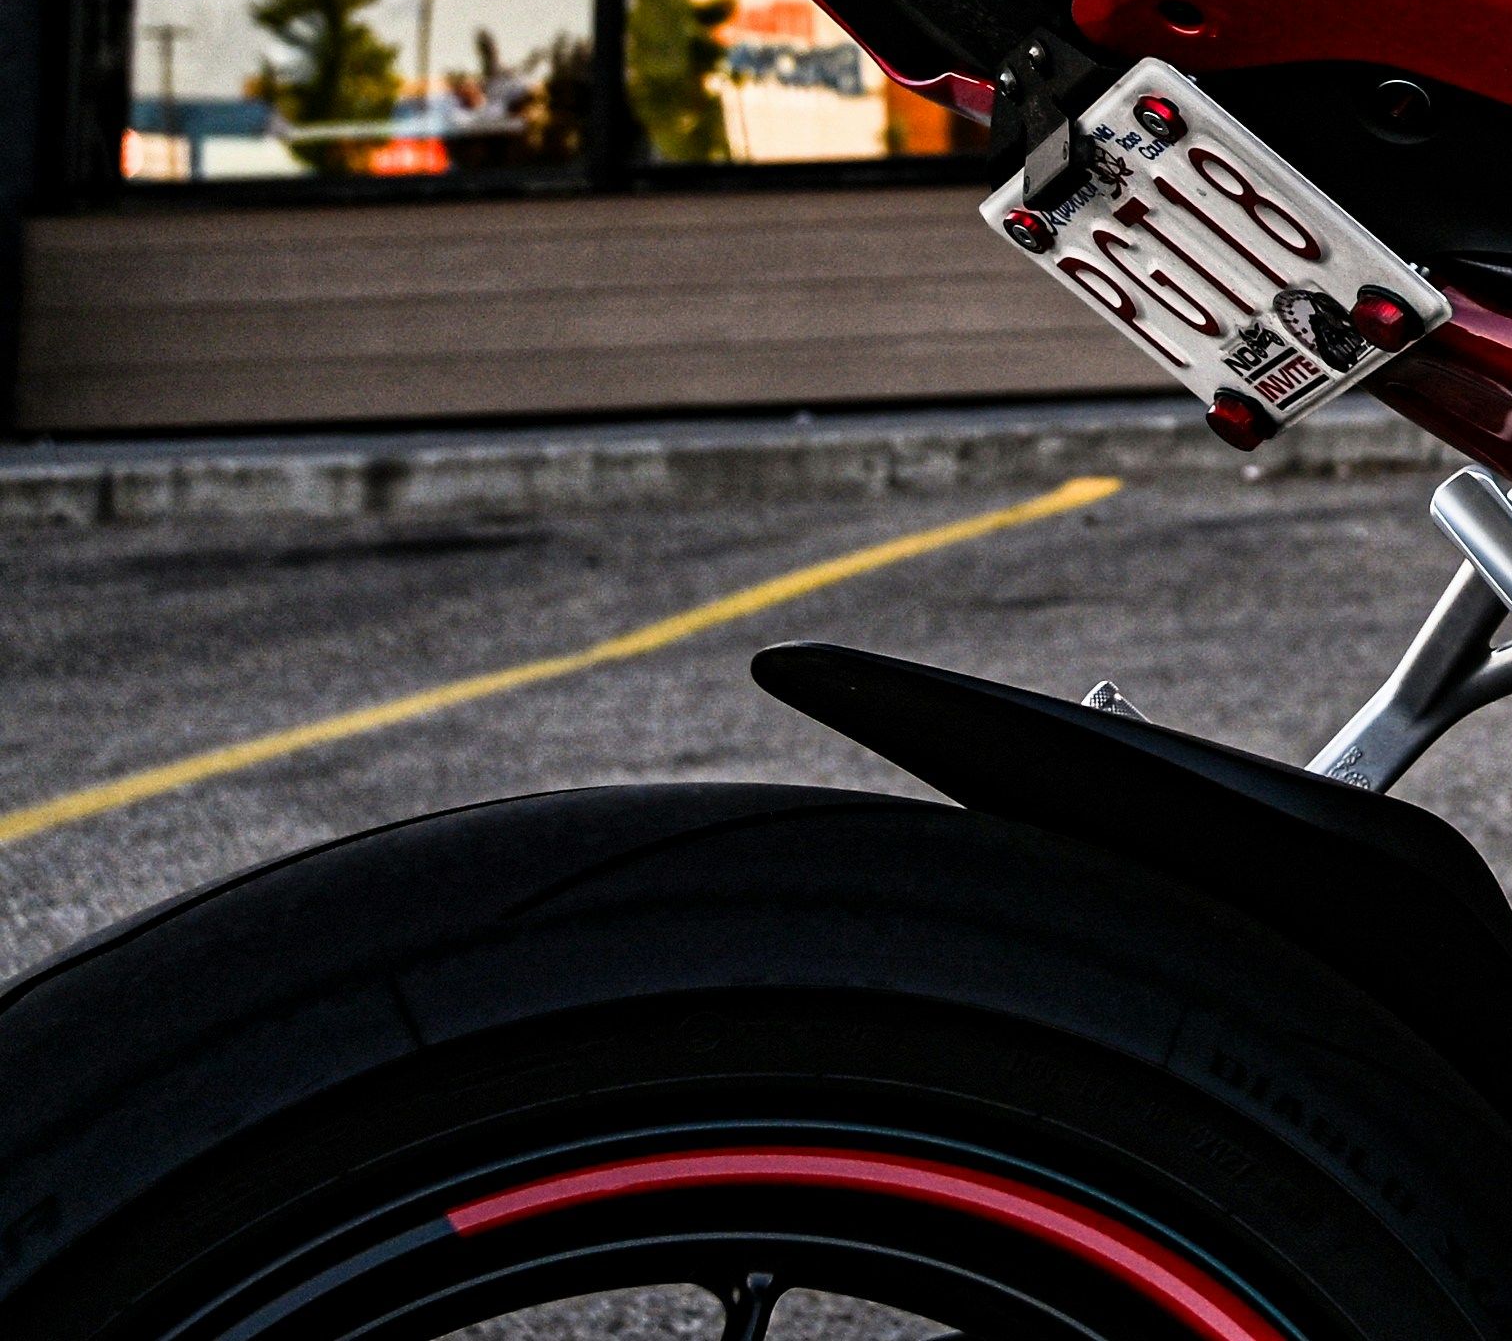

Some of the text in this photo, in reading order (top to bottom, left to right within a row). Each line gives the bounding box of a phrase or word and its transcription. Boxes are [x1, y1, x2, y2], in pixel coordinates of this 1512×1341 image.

[1138, 138, 1175, 160] Coun
[1055, 146, 1323, 369] PGT18
[1223, 346, 1259, 379] NO
[1254, 353, 1320, 405] INVITE
